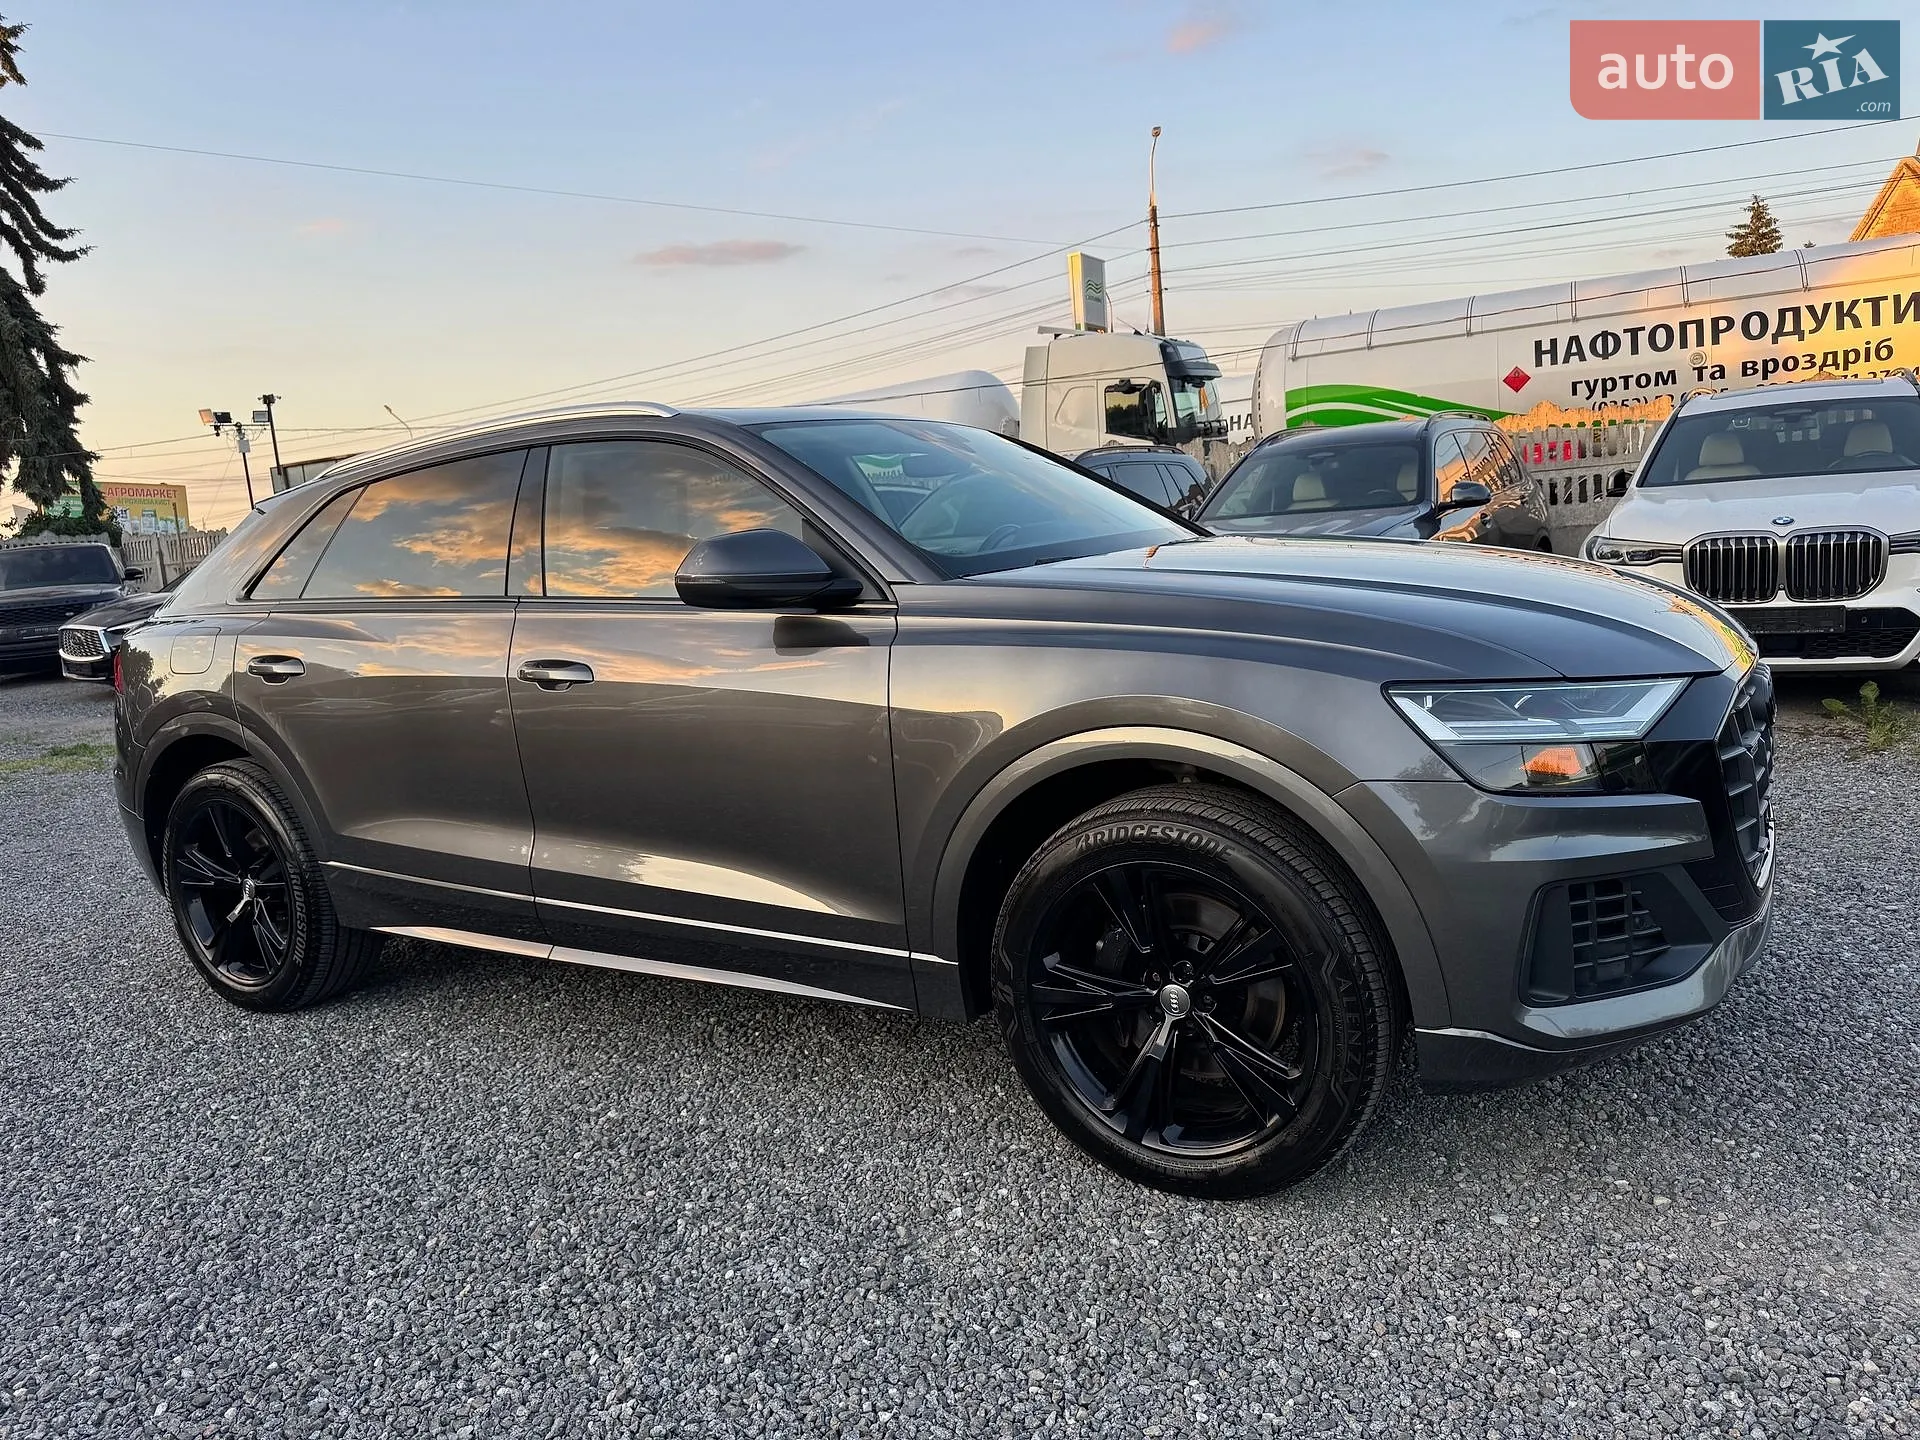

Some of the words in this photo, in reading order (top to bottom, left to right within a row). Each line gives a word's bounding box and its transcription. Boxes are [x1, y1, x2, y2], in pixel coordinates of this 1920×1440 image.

[1534, 291, 1920, 368] НАФТОПРОДУКТИ
[1571, 368, 1677, 400] гуртом
[1692, 362, 1726, 382] та
[1741, 337, 1894, 380] вроздріб
[107, 487, 177, 499] АГРОМАРКЕТ
[1075, 823, 1236, 863] BRIDGESTONE
[286, 860, 307, 967] BRIDGESTONE
